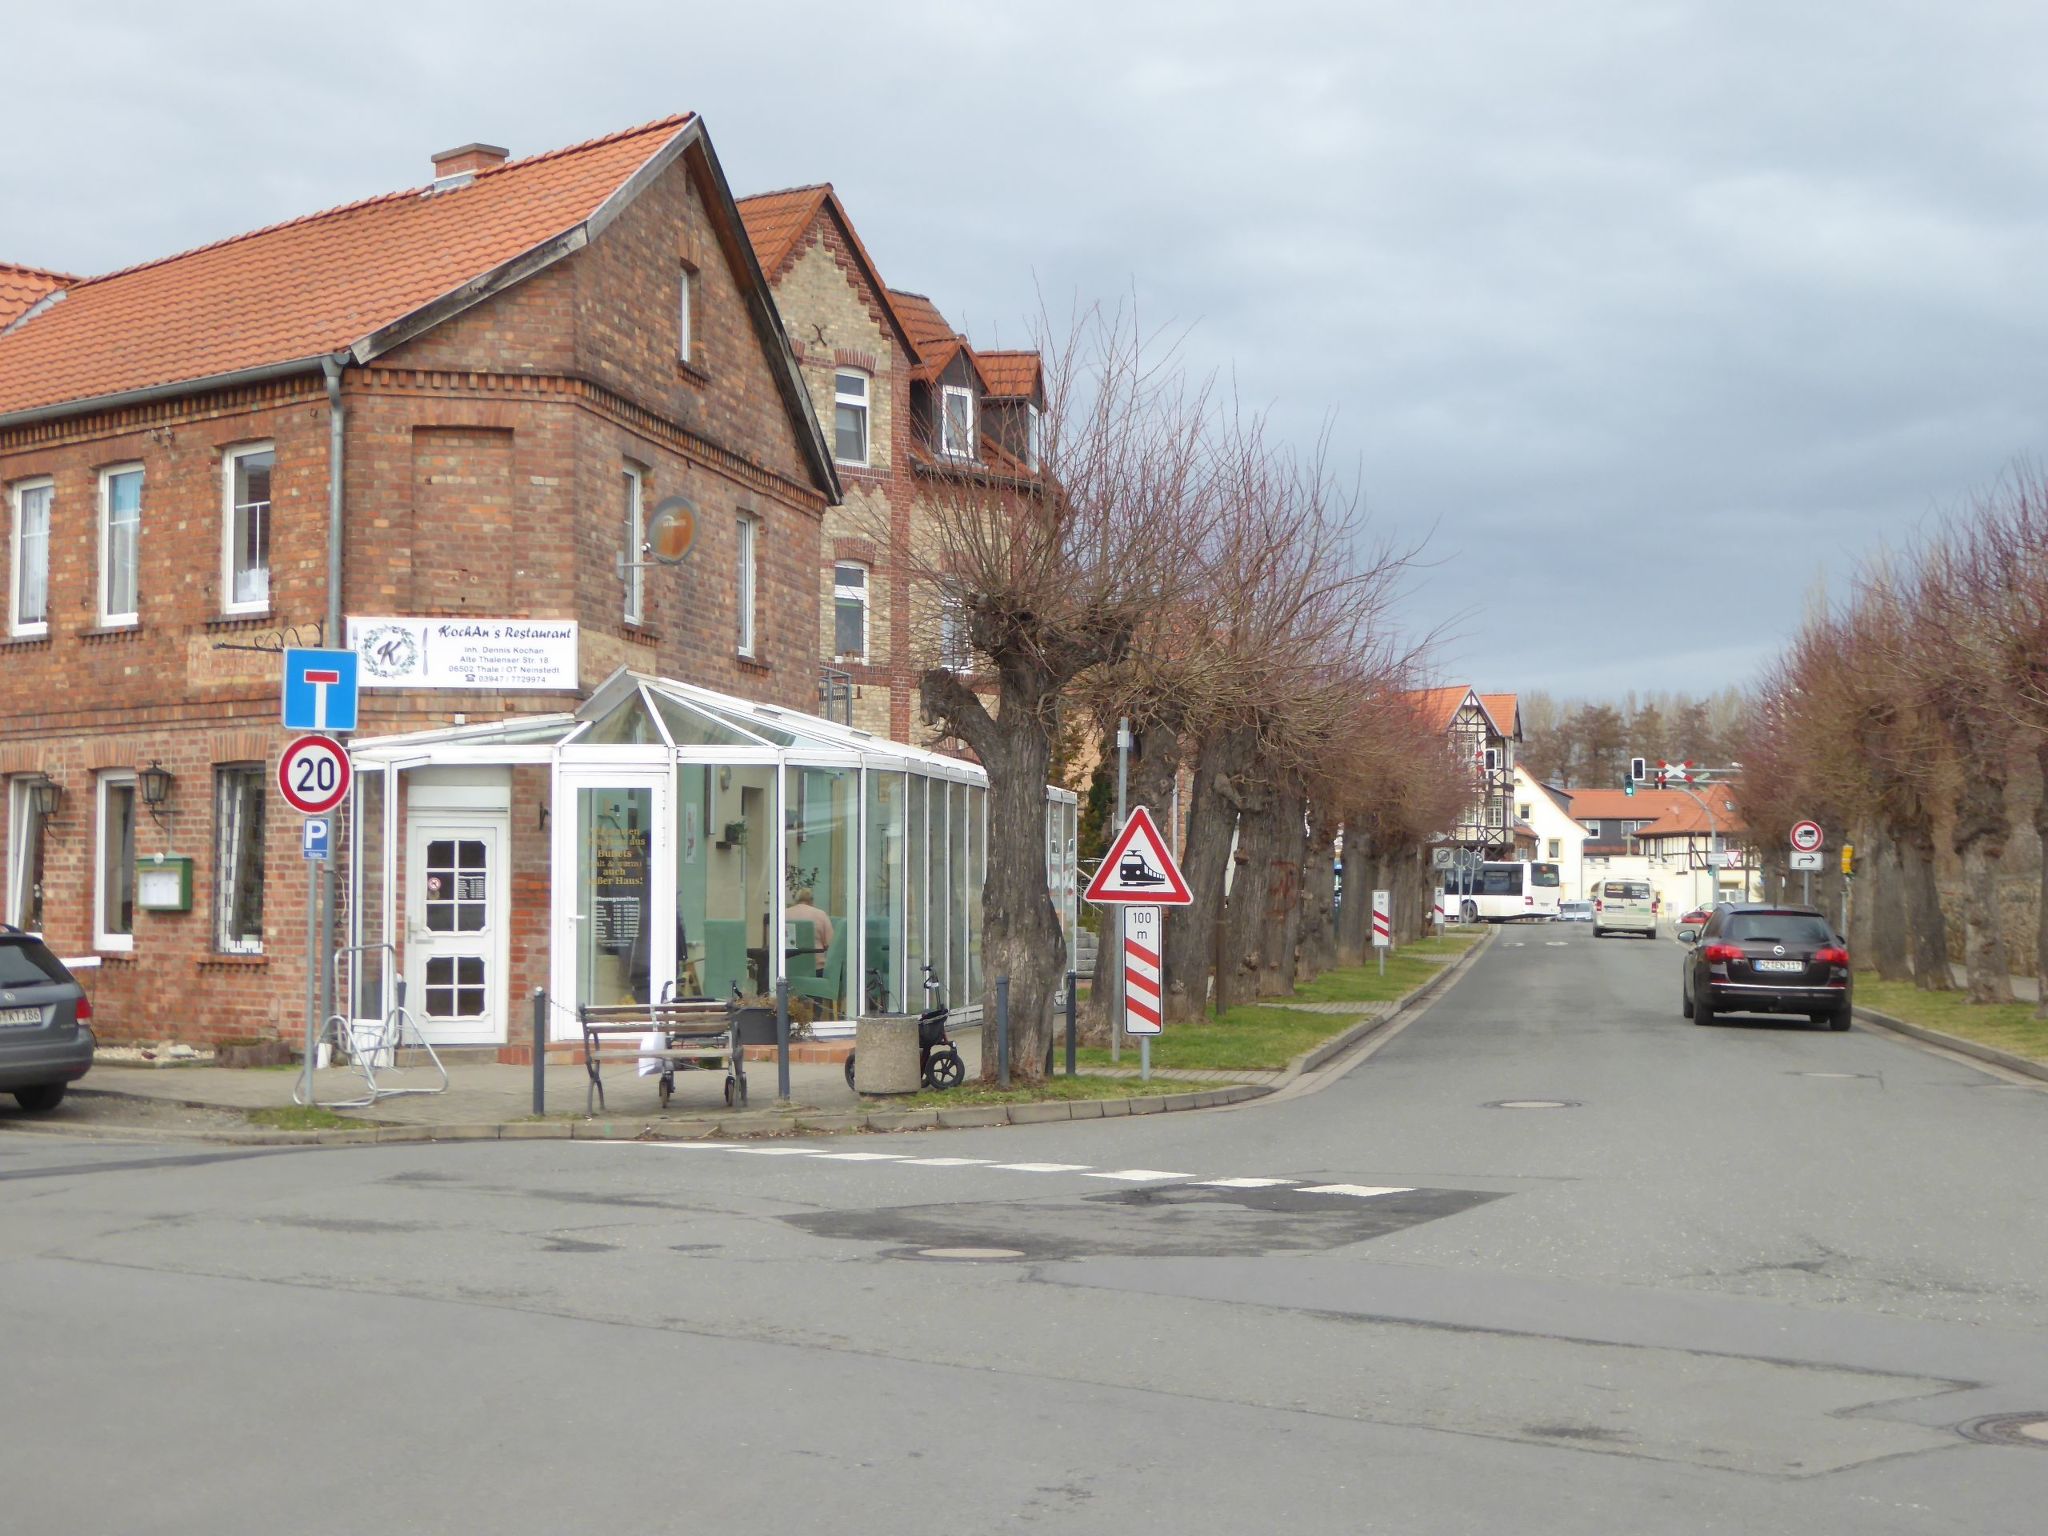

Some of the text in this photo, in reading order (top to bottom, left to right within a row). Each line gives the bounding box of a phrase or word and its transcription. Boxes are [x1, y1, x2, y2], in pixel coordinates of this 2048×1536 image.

[505, 626, 571, 640] Restaurant
[377, 641, 401, 666] K
[482, 646, 511, 654] Dennis
[513, 647, 544, 655] Kochan
[480, 656, 519, 664] Thalenser
[448, 665, 474, 673] 06502
[477, 665, 500, 673] Thale
[520, 666, 560, 674] Neinstedt
[297, 757, 334, 791] 20
[305, 820, 327, 849] P
[1133, 912, 1152, 924] 100
[1137, 931, 1148, 939] m
